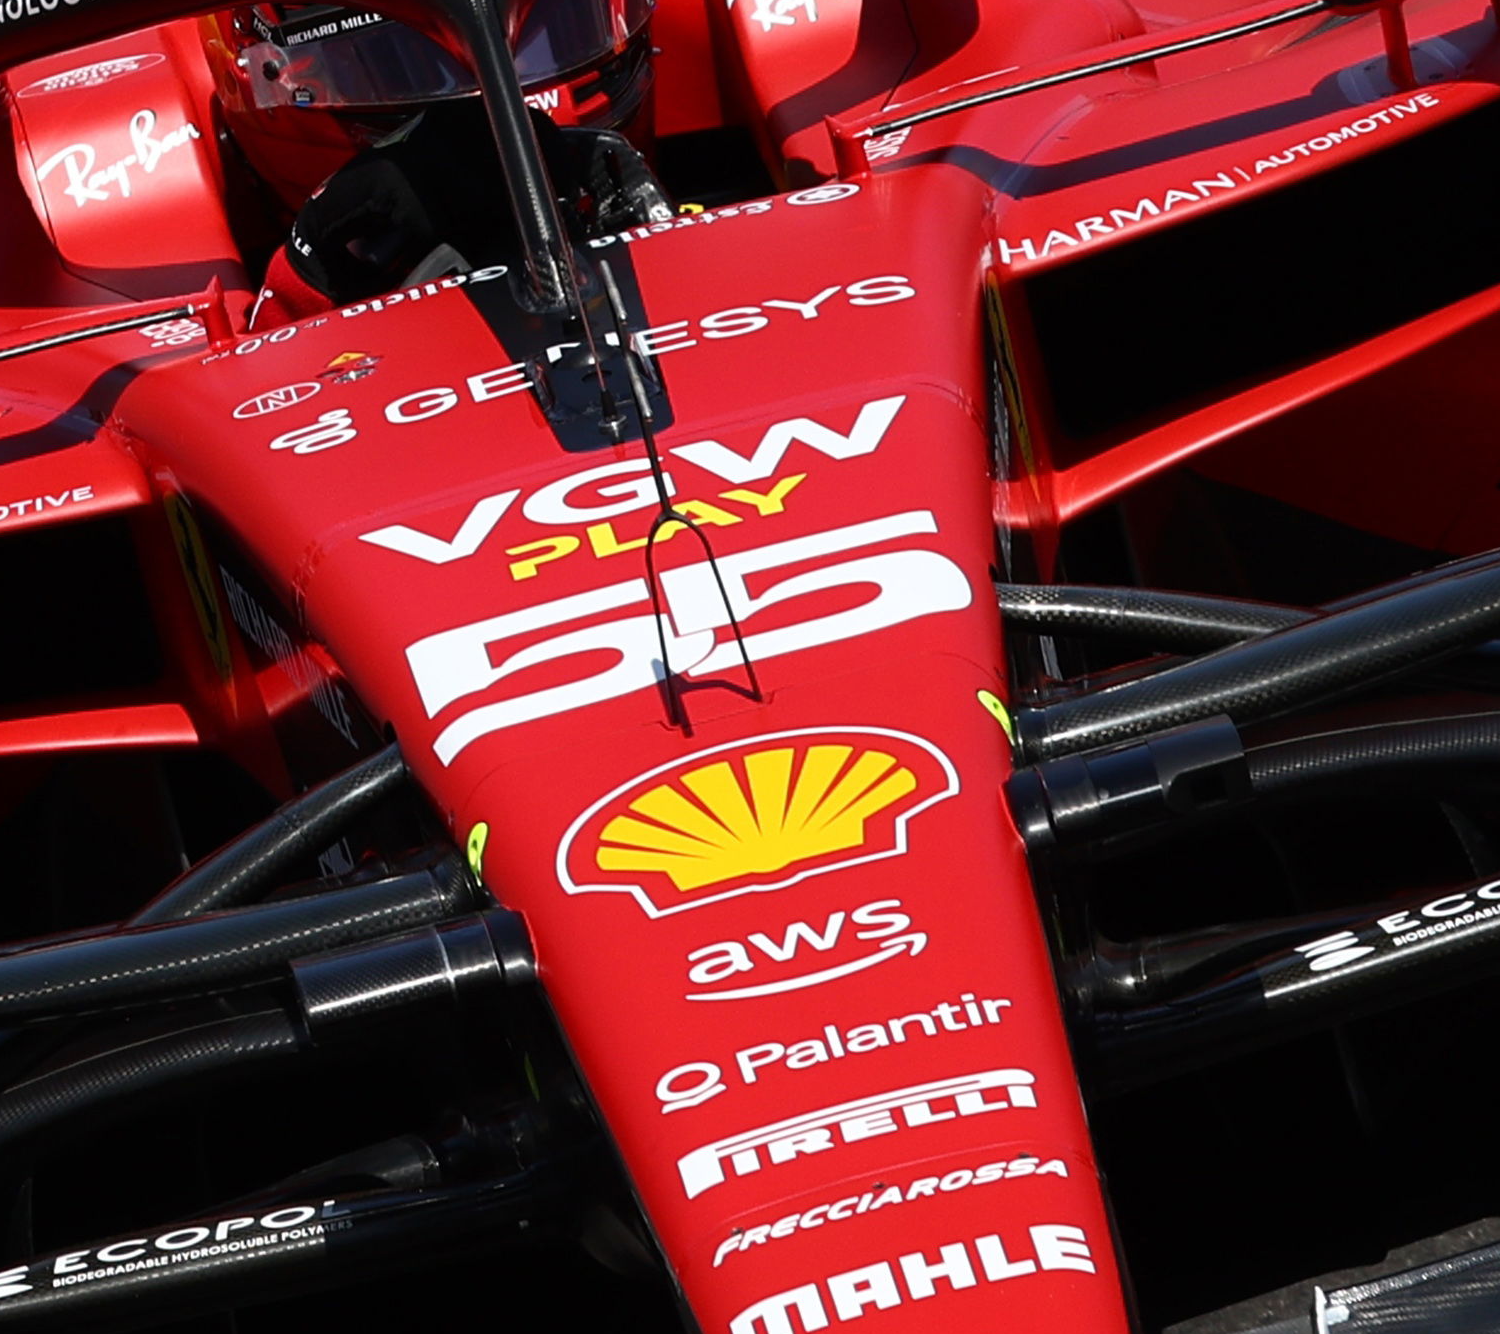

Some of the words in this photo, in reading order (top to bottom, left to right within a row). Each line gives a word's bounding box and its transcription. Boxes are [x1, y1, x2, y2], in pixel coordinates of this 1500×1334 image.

[286, 21, 338, 47] RICHARD
[340, 11, 384, 33] MILLE
[37, 108, 200, 207] Ray-Ban
[999, 171, 1237, 264] HARMAN
[1255, 93, 1439, 175] AUTOMOTIVE
[589, 197, 774, 249] Estrella
[341, 265, 509, 318] Galicia
[358, 395, 906, 565] VGW
[506, 473, 807, 581] PLAY
[404, 509, 973, 768] 55
[686, 898, 912, 986] aws
[735, 994, 1014, 1085] Palantir
[676, 1067, 1039, 1201] PIRELLI
[53, 1198, 352, 1275] ECOPOL
[711, 1154, 1070, 1269] FRECCIAROSSA
[51, 1255, 169, 1288] BIODEGRADABLE
[170, 1234, 278, 1265] HYDROSOLUBLE
